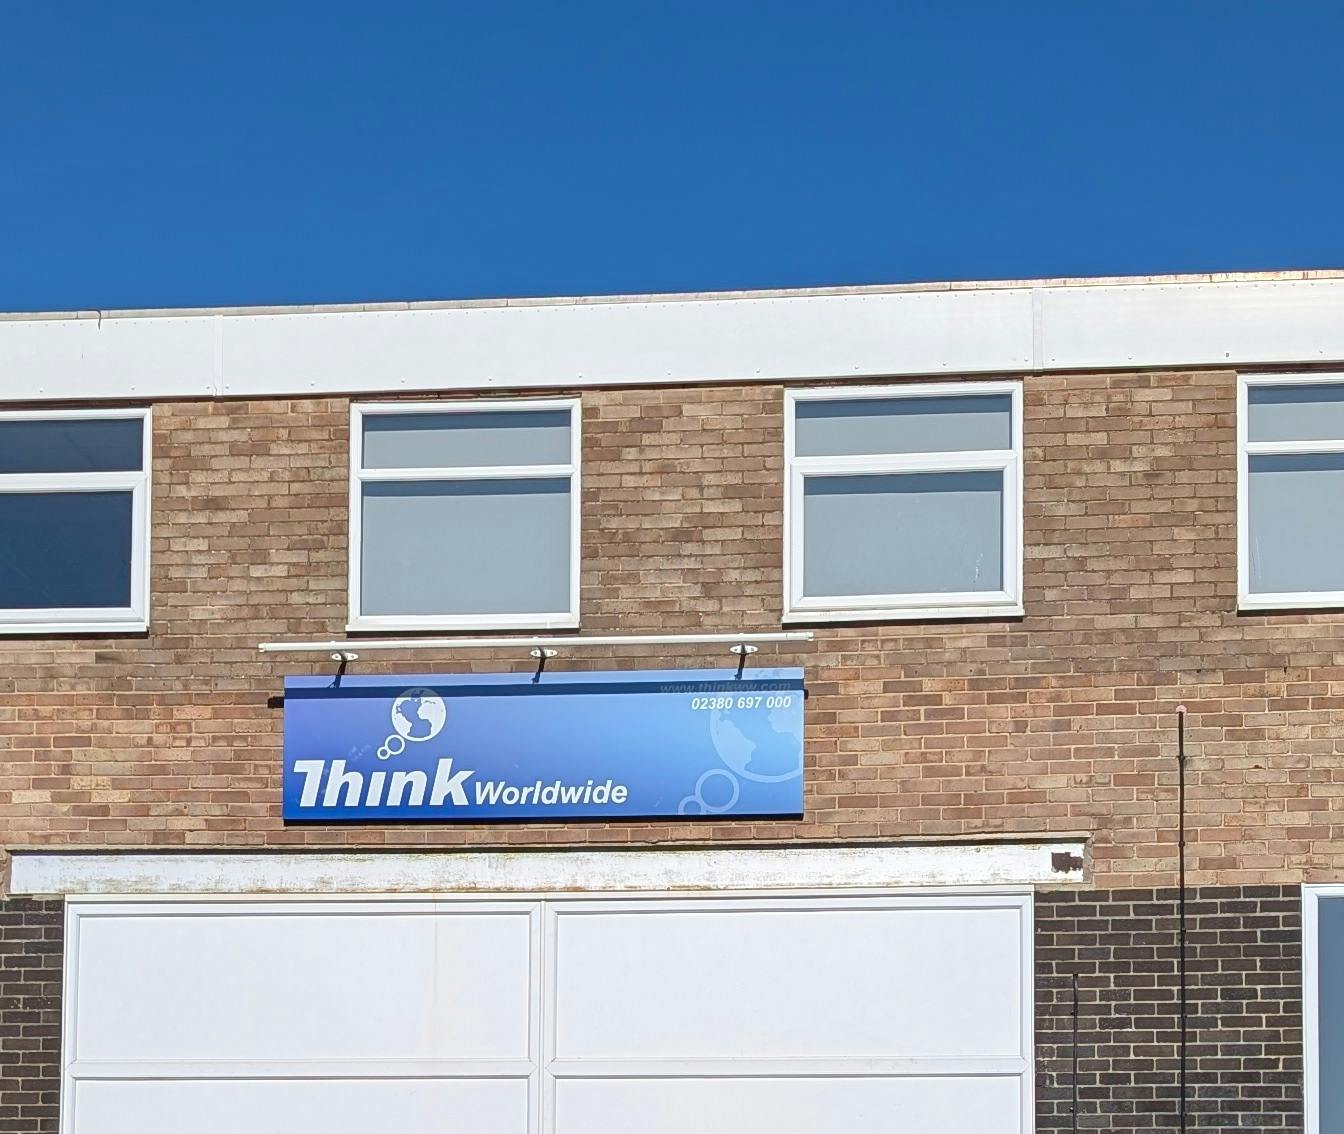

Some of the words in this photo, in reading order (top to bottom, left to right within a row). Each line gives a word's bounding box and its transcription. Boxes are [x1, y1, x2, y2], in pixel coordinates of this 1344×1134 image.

[691, 697, 733, 710] 02380
[737, 696, 763, 709] 697
[766, 696, 792, 708] 000
[292, 757, 476, 808] Think
[475, 778, 628, 806] Worldwide
